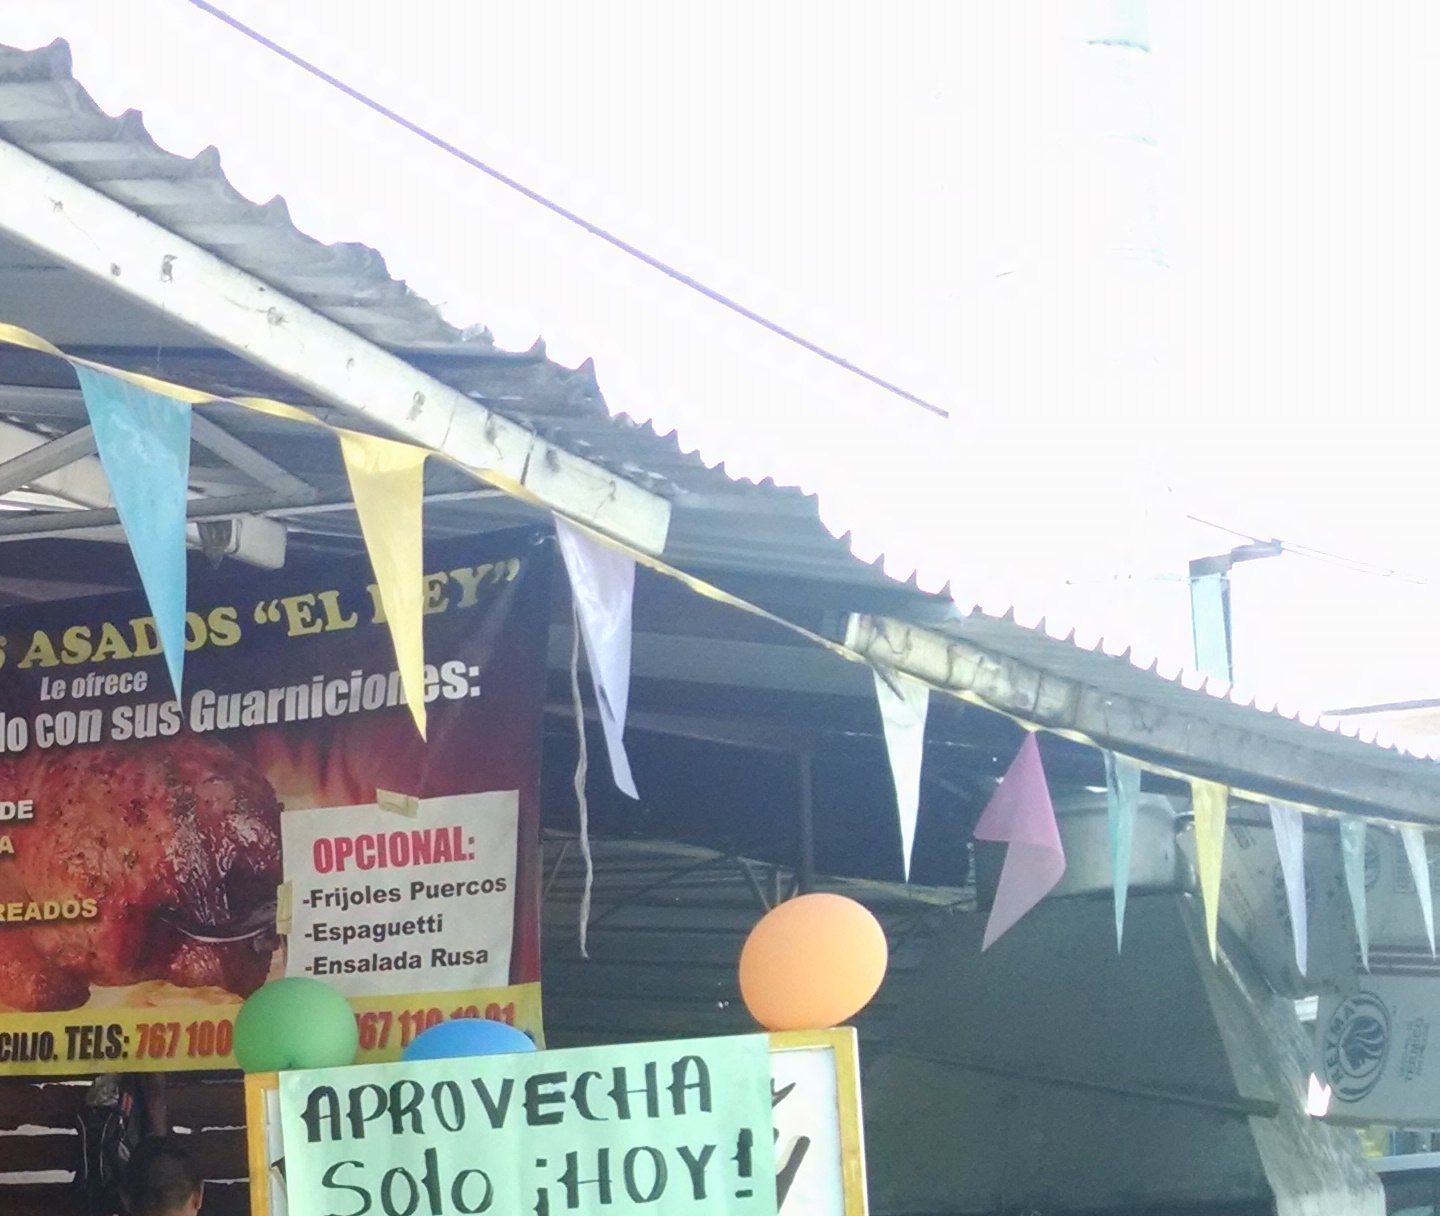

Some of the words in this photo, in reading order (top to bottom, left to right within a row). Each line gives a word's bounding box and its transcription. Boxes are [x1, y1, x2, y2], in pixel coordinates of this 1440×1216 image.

[17, 606, 242, 669] ASADOS
[34, 707, 103, 749] con
[111, 700, 181, 741] sus
[190, 660, 481, 733] Guarniciones:
[40, 676, 66, 701] Le
[71, 670, 149, 699] ofrece
[313, 825, 476, 874] OPCIONAL:
[302, 885, 402, 911] -Frijoles
[410, 876, 507, 901] Puercos
[304, 913, 444, 945] -Espaguetti
[304, 951, 422, 975] -Ensalada
[430, 947, 489, 968] Rusa
[65, 1022, 131, 1060] TELS:
[135, 1021, 181, 1058] 767
[186, 1018, 233, 1058] 100
[300, 1055, 713, 1143] APROVECHA
